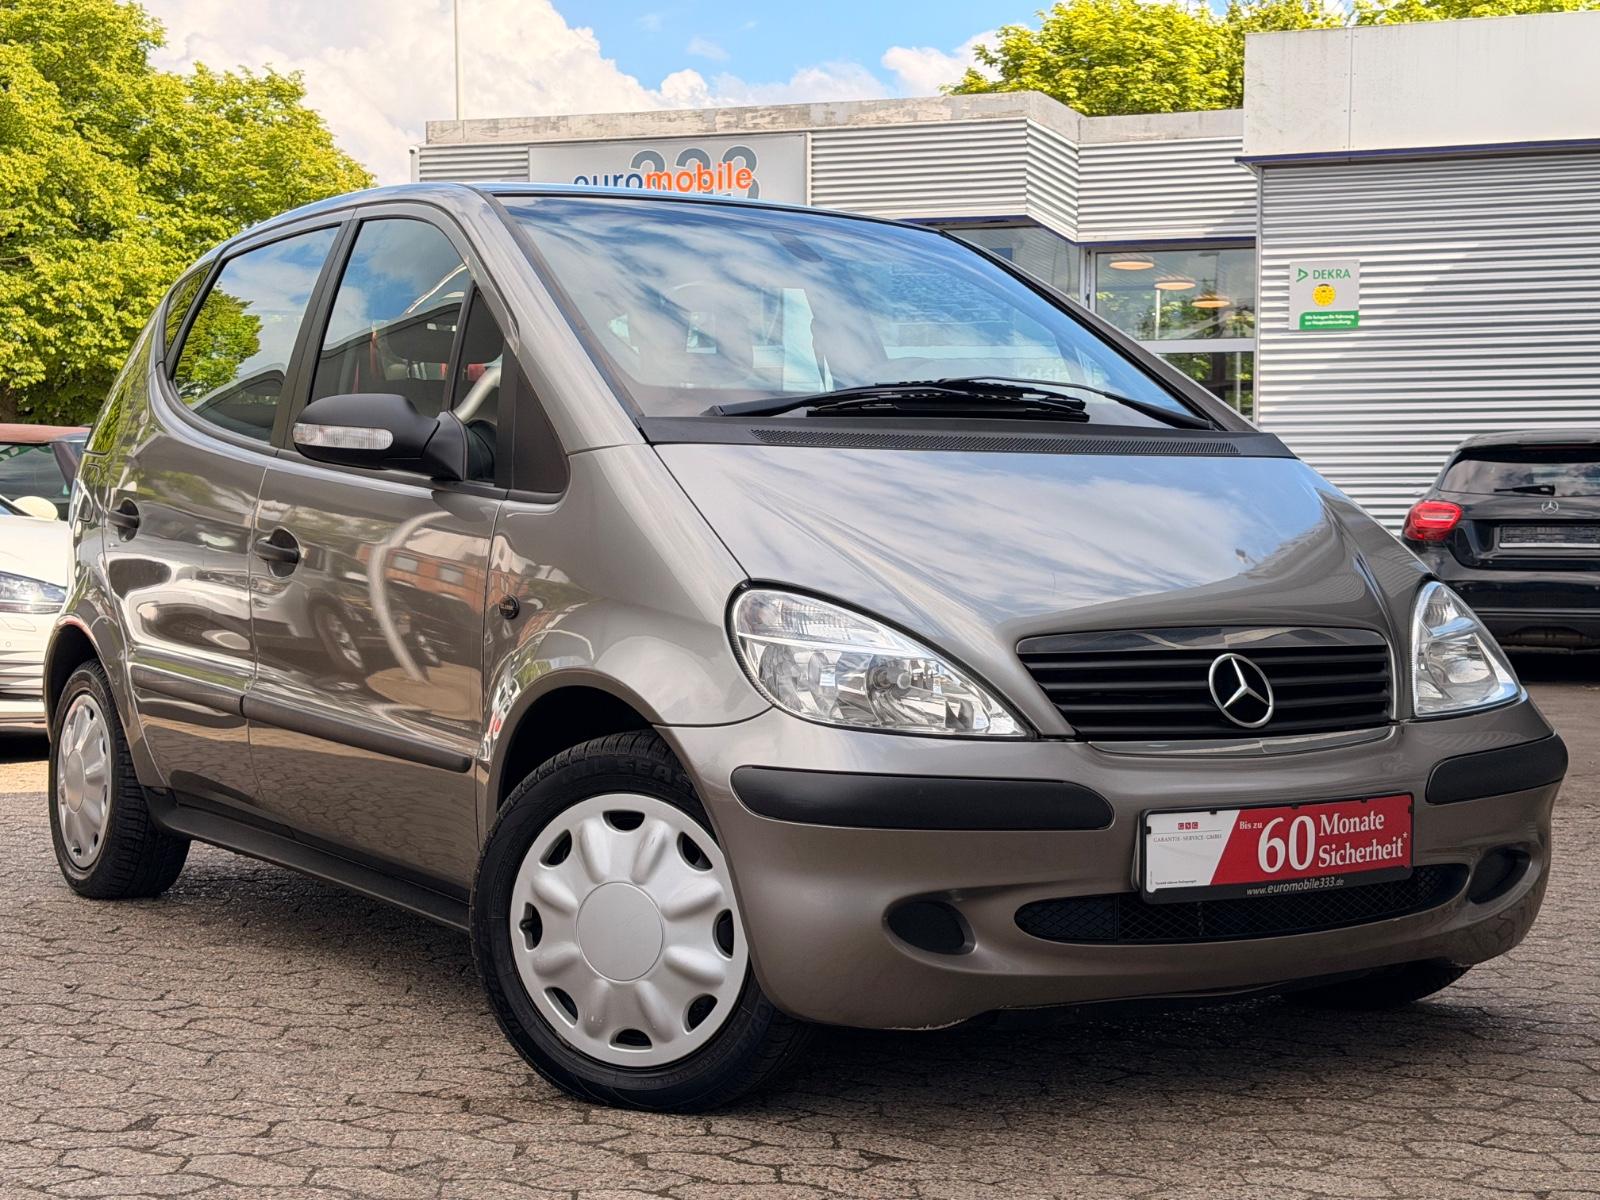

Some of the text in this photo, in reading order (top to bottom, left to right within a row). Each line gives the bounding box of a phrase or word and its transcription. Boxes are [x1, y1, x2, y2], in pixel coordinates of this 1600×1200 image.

[1312, 268, 1351, 280] DEKRA
[1318, 811, 1385, 836] Monate
[1239, 815, 1316, 873] Bis zu 60
[1246, 876, 1345, 895] www.euromobile333.de
